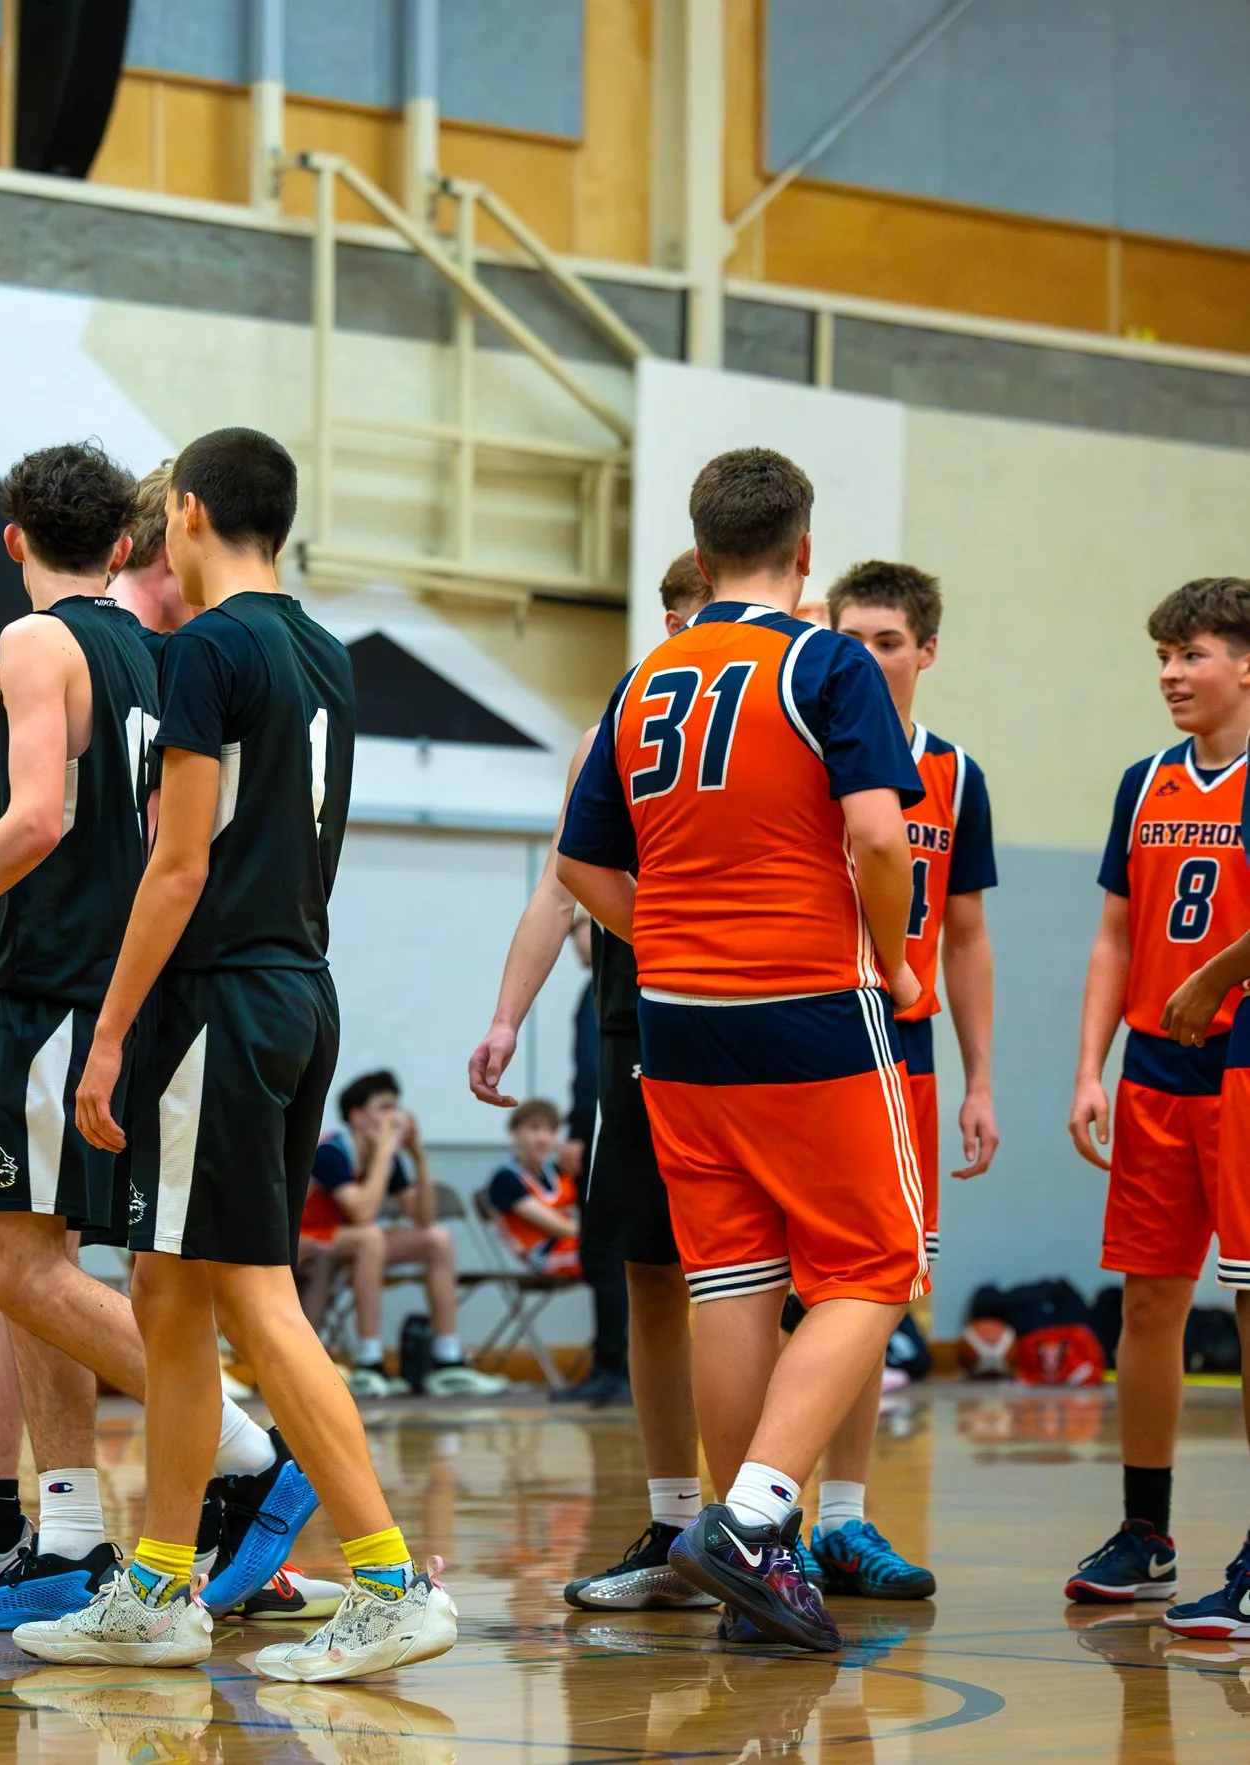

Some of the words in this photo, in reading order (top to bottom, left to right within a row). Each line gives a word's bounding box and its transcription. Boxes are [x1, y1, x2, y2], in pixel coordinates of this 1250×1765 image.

[94, 599, 115, 607] NIKE
[630, 661, 759, 806] 31
[1166, 856, 1220, 943] 8
